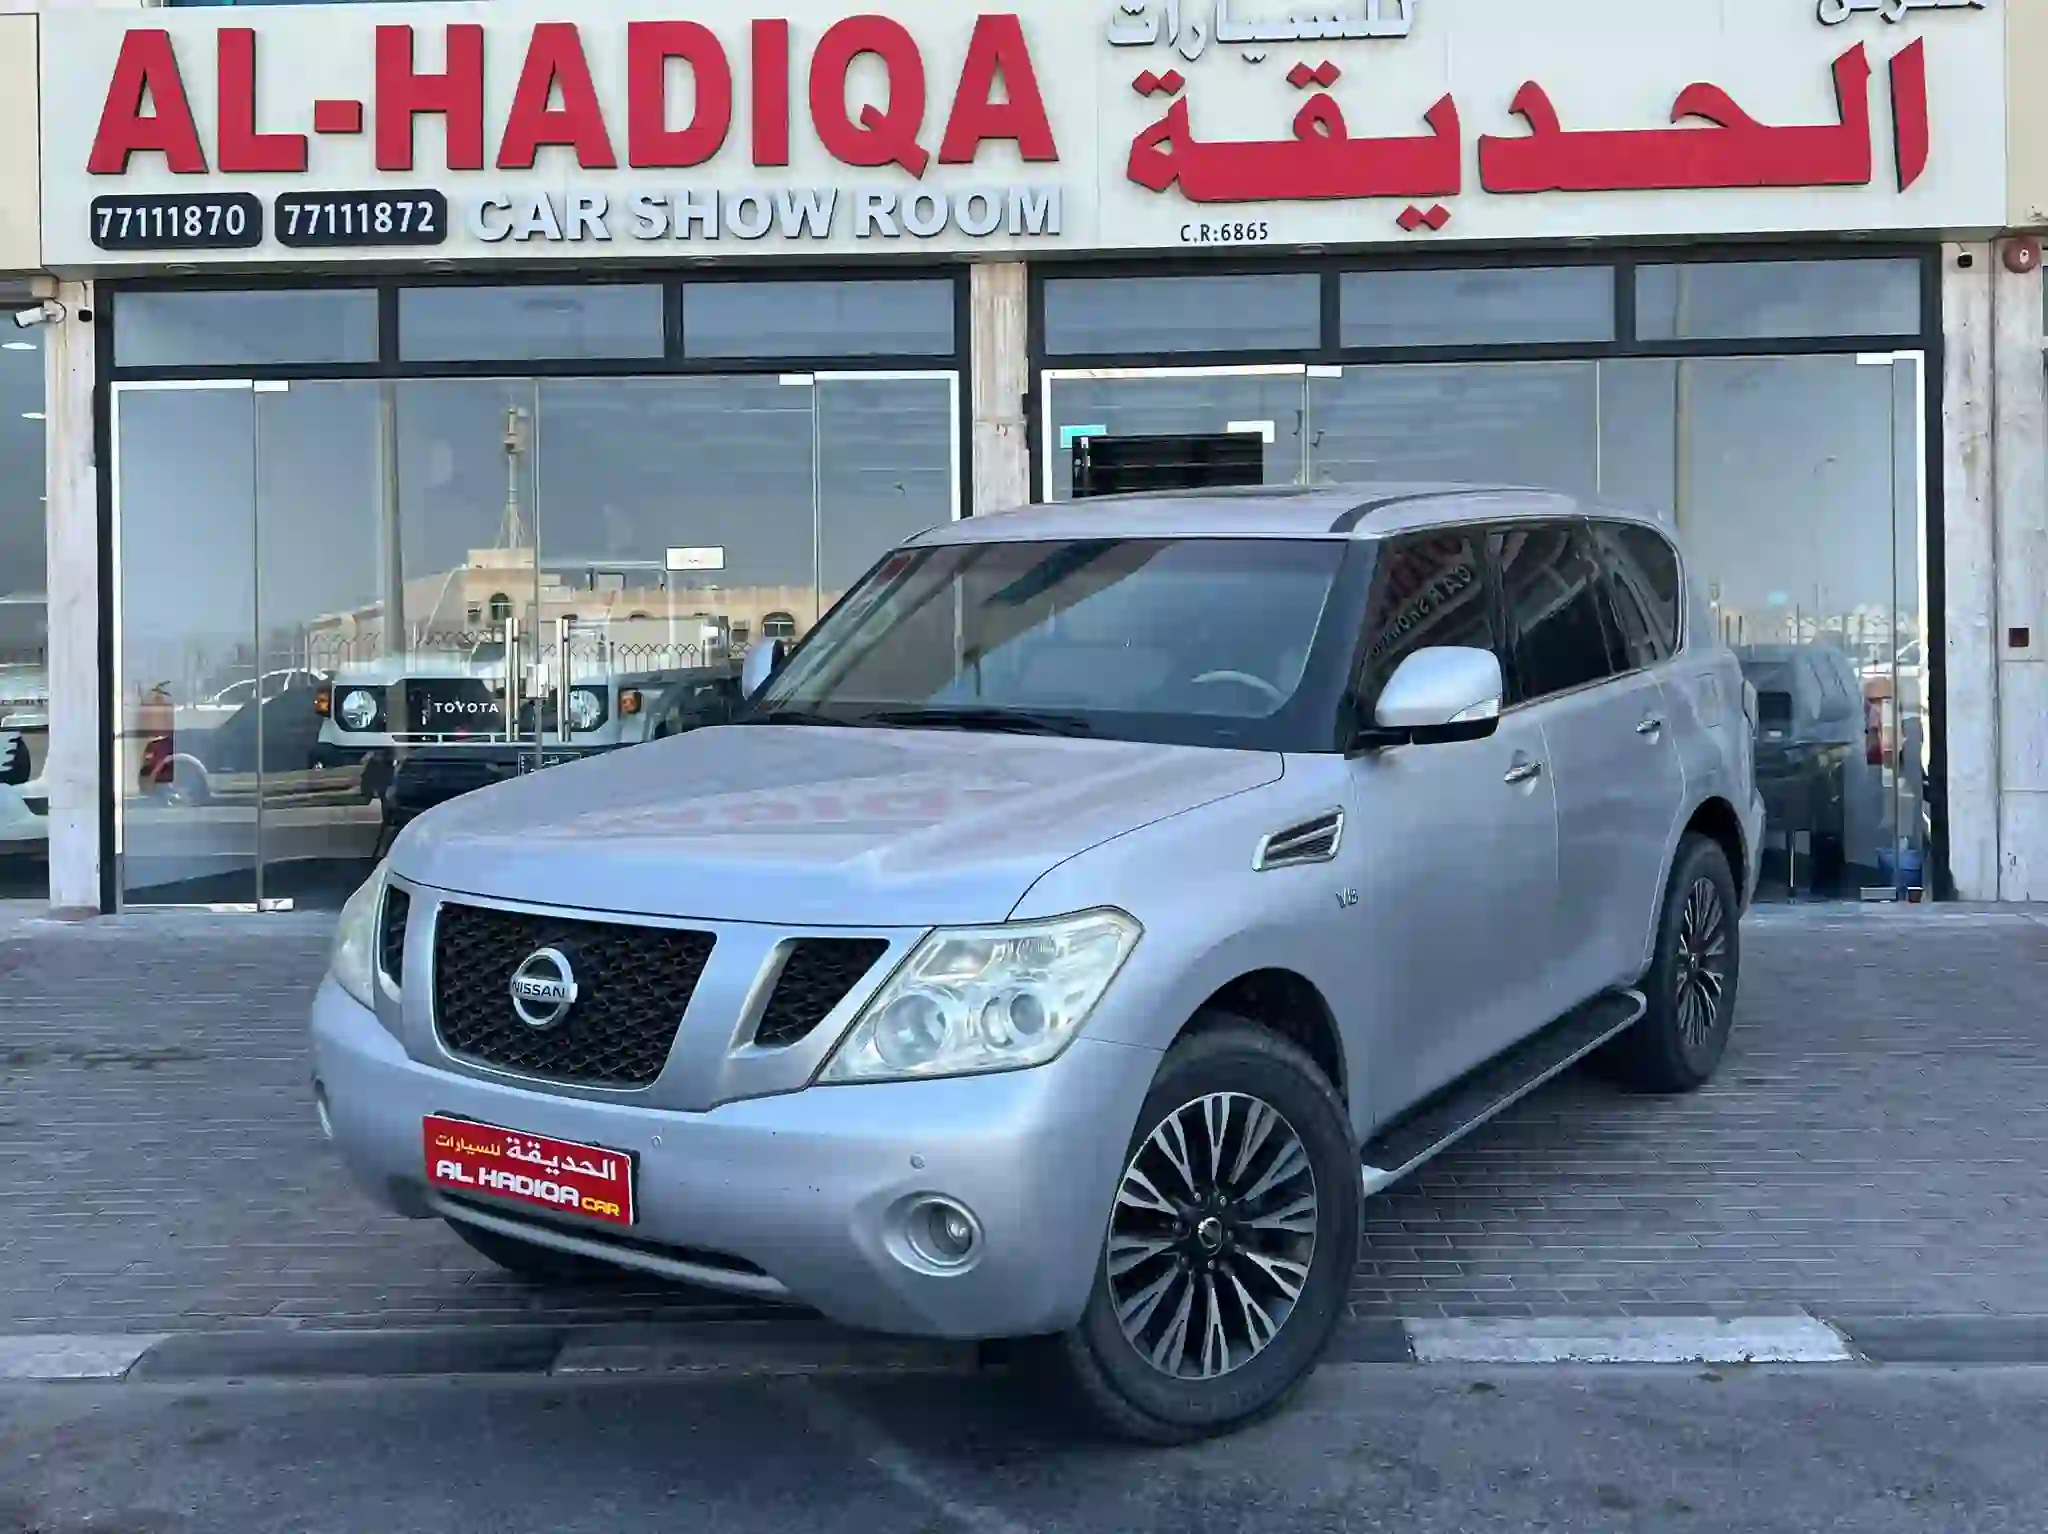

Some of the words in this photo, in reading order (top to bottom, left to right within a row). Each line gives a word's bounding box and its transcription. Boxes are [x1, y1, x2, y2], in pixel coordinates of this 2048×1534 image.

[86, 13, 1060, 180] AL-HADIQA
[1126, 36, 1929, 232] الحديقة
[97, 205, 246, 239] 77111870
[285, 201, 434, 236] 77111872
[468, 194, 612, 243] CAR
[629, 188, 838, 241] SHOW
[855, 186, 1063, 239] ROOM
[433, 701, 500, 714] TOYOTA
[511, 980, 566, 998] NISSAN
[435, 1131, 501, 1156] للسيارات
[506, 1136, 616, 1181] الحديقة
[436, 1159, 474, 1184] AL
[581, 1196, 621, 1217] CAR
